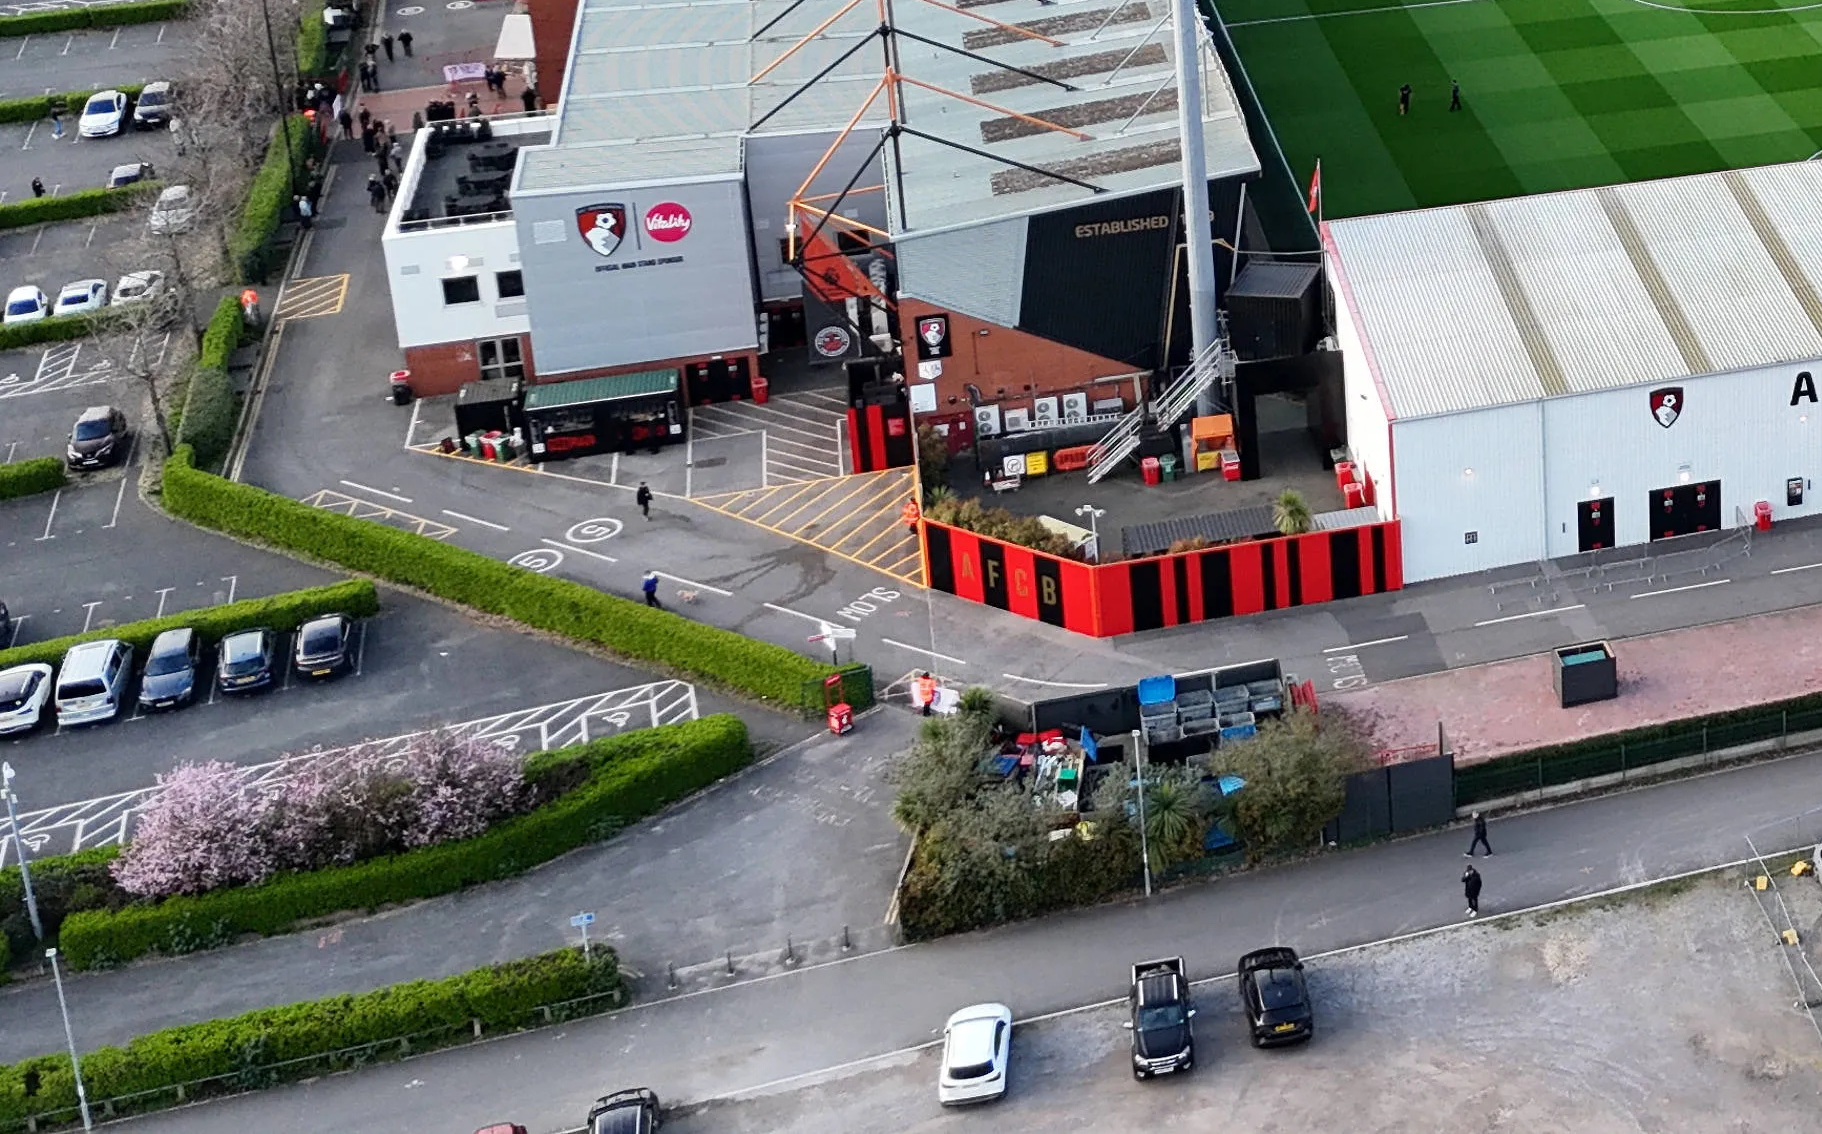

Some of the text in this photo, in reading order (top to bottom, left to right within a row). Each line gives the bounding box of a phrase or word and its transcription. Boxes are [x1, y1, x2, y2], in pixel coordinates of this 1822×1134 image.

[646, 213, 691, 232] Vitality
[1075, 215, 1169, 239] ESTABLISHED
[581, 524, 611, 537] 5
[836, 586, 901, 622] SLOW
